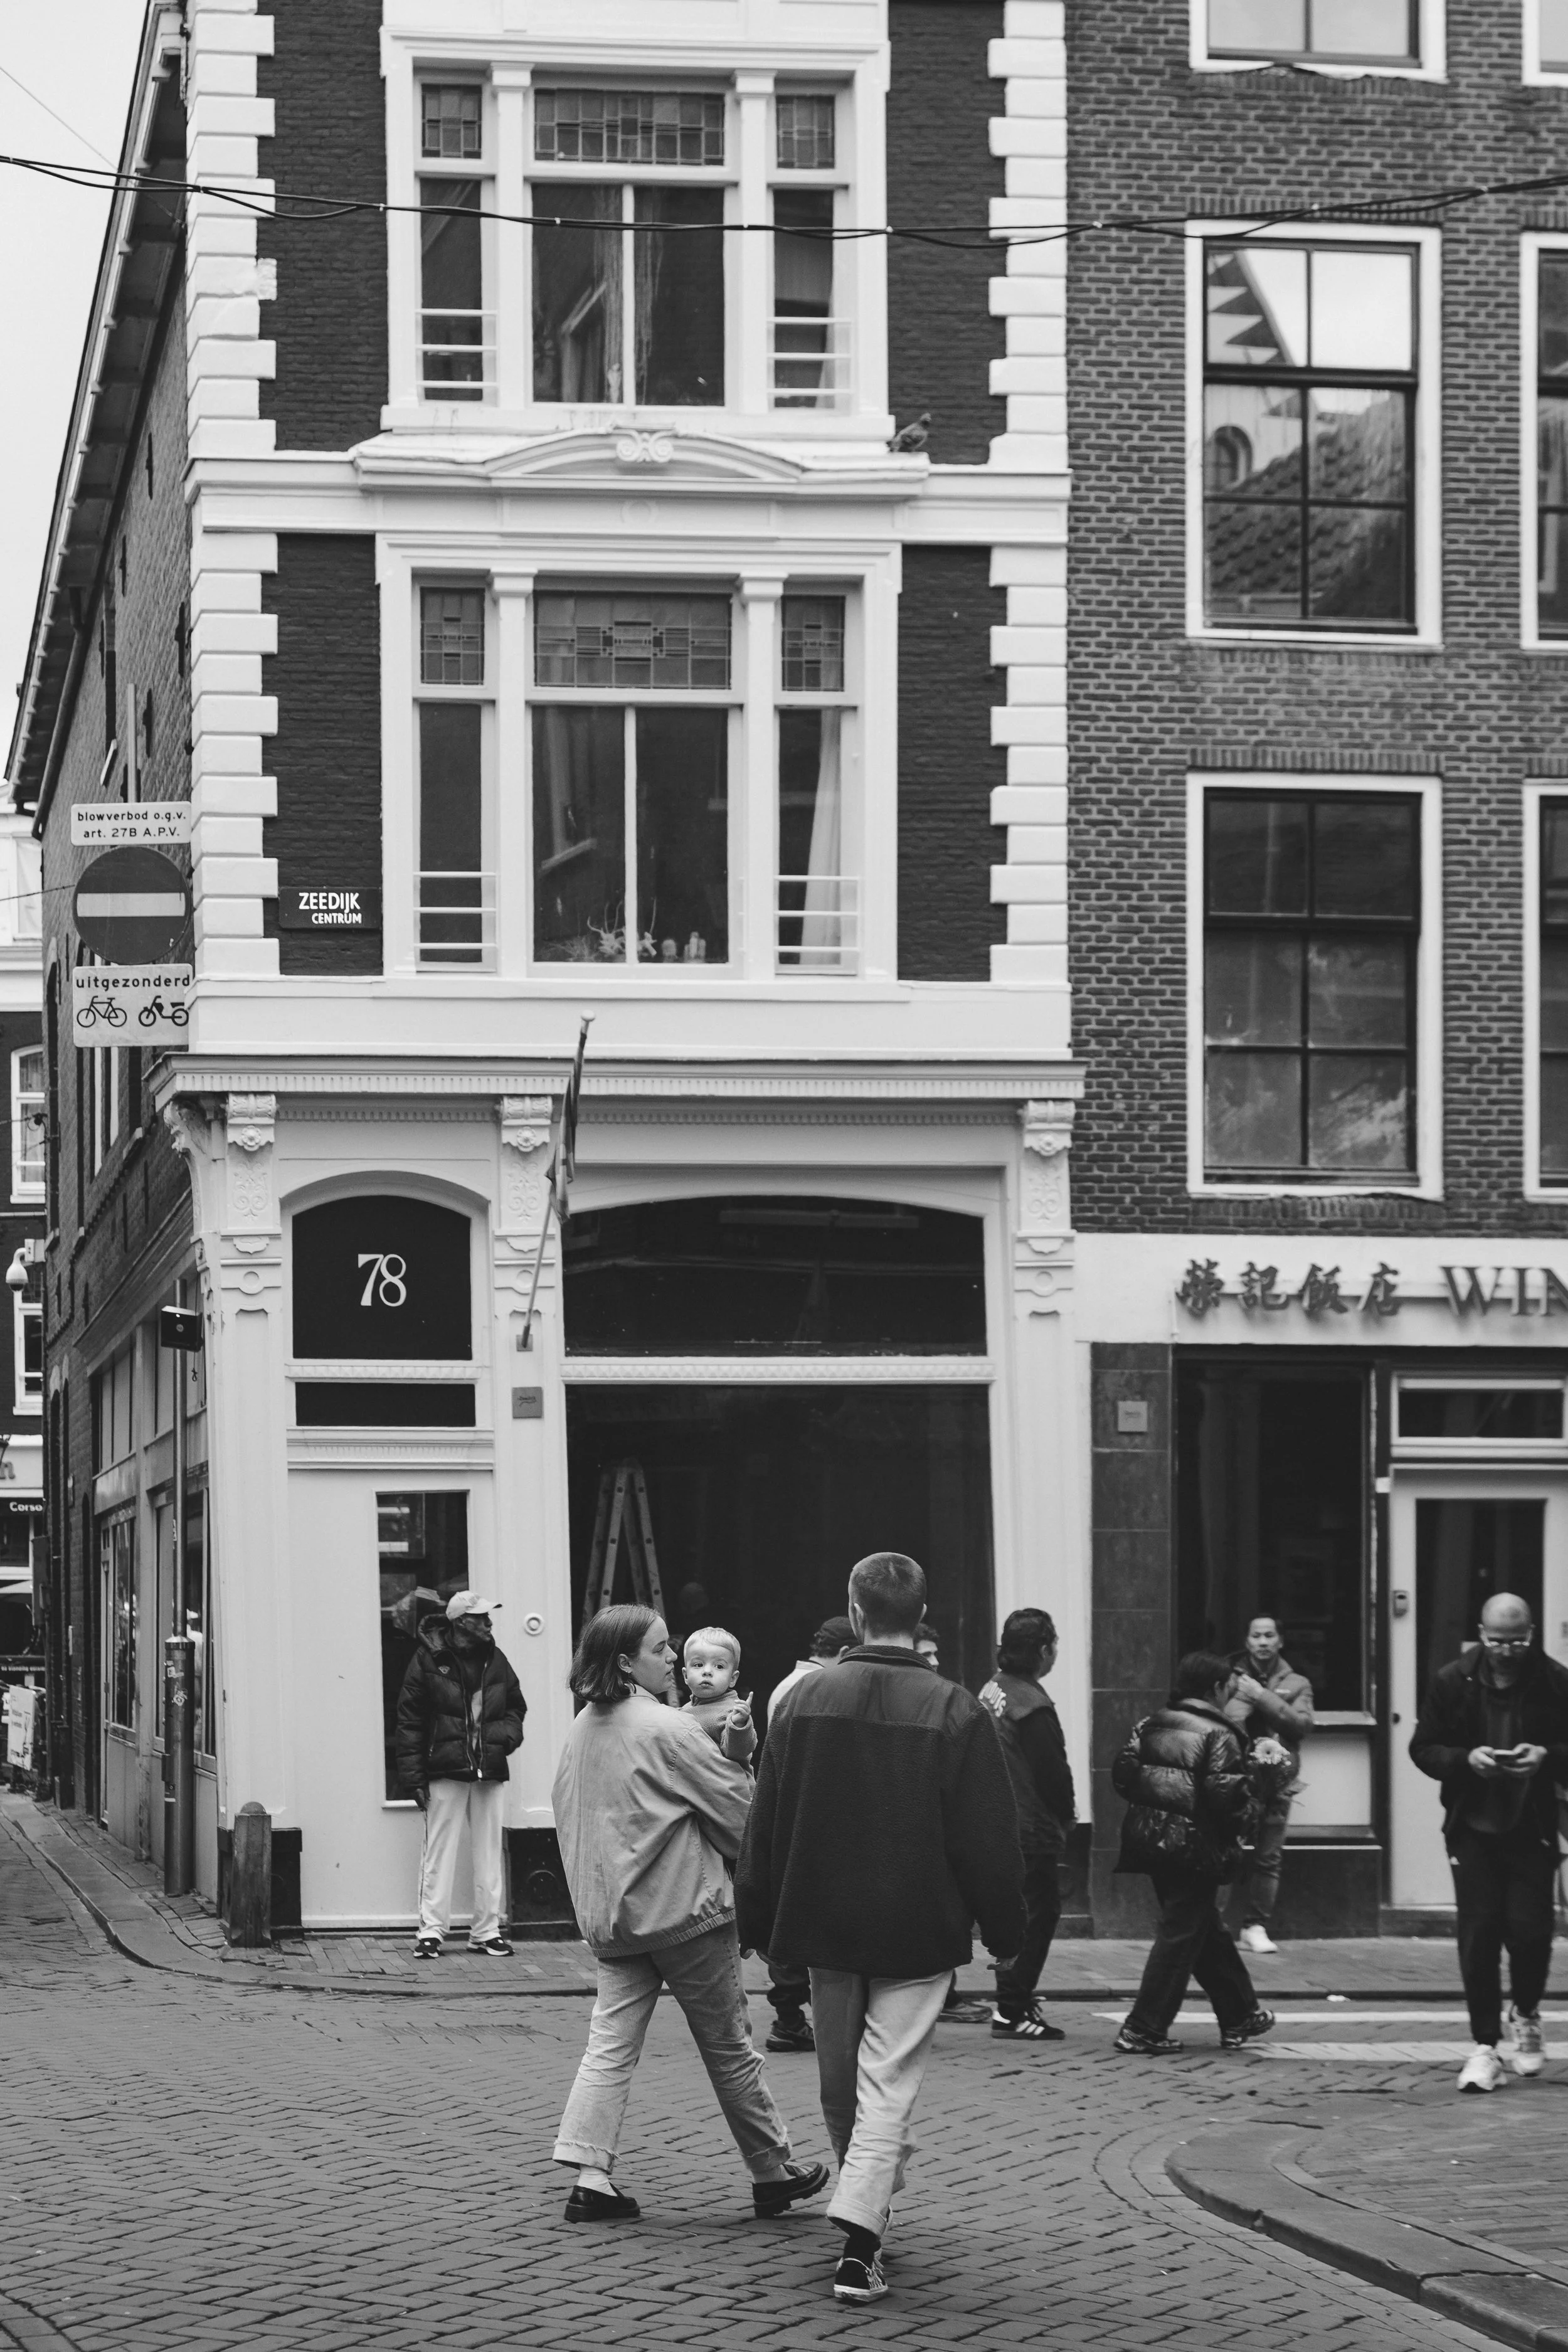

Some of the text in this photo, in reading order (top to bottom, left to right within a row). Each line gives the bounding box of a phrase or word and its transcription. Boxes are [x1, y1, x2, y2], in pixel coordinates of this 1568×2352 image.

[77, 810, 186, 822] blowverbod o.g.v.
[83, 827, 180, 838] art. 27B A.P.V.
[298, 892, 361, 914] ZEEDIJK
[311, 913, 362, 924] CENTRUM
[76, 974, 190, 992] uitgezonderd
[358, 1253, 407, 1307] 78
